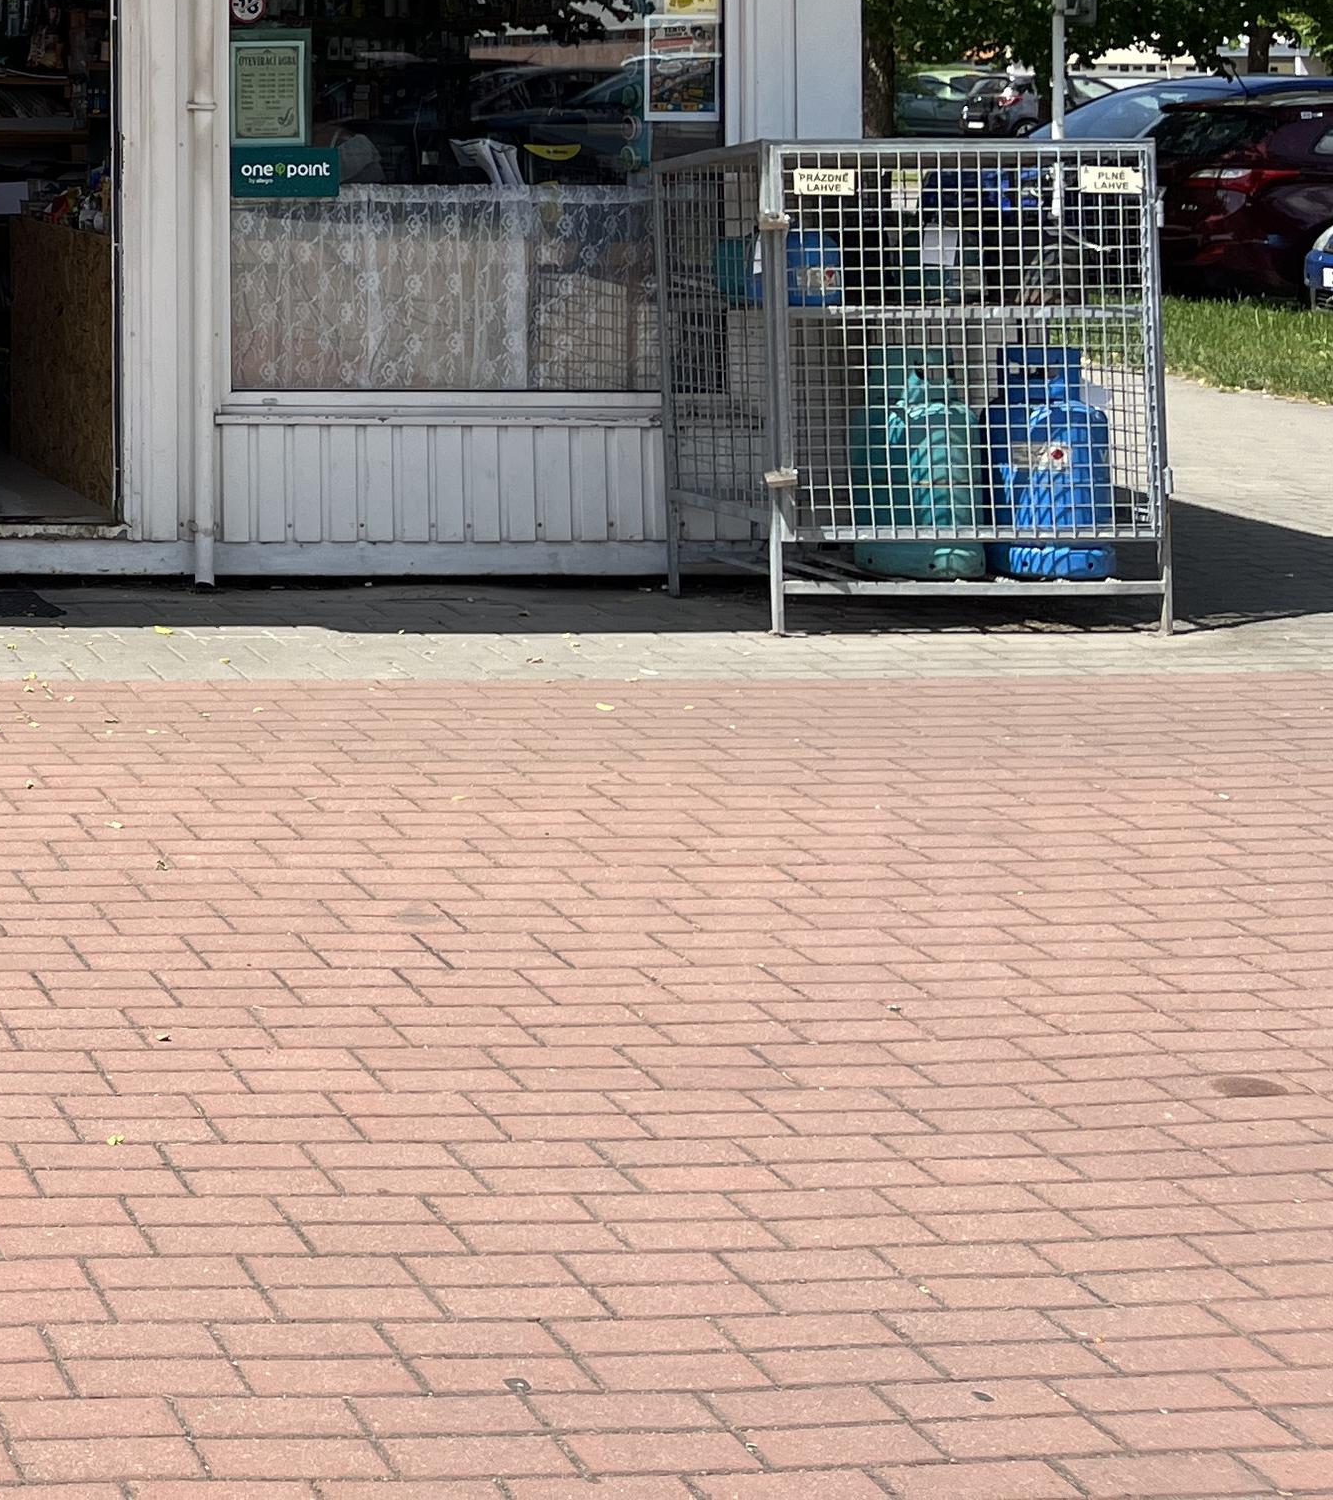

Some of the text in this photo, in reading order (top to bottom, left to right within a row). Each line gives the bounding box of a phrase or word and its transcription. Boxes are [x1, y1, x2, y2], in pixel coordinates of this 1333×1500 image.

[241, 162, 331, 178] one point
[1097, 170, 1126, 181] PLNÉ
[806, 184, 842, 192] LAHVE
[1094, 182, 1129, 190] LAHVE
